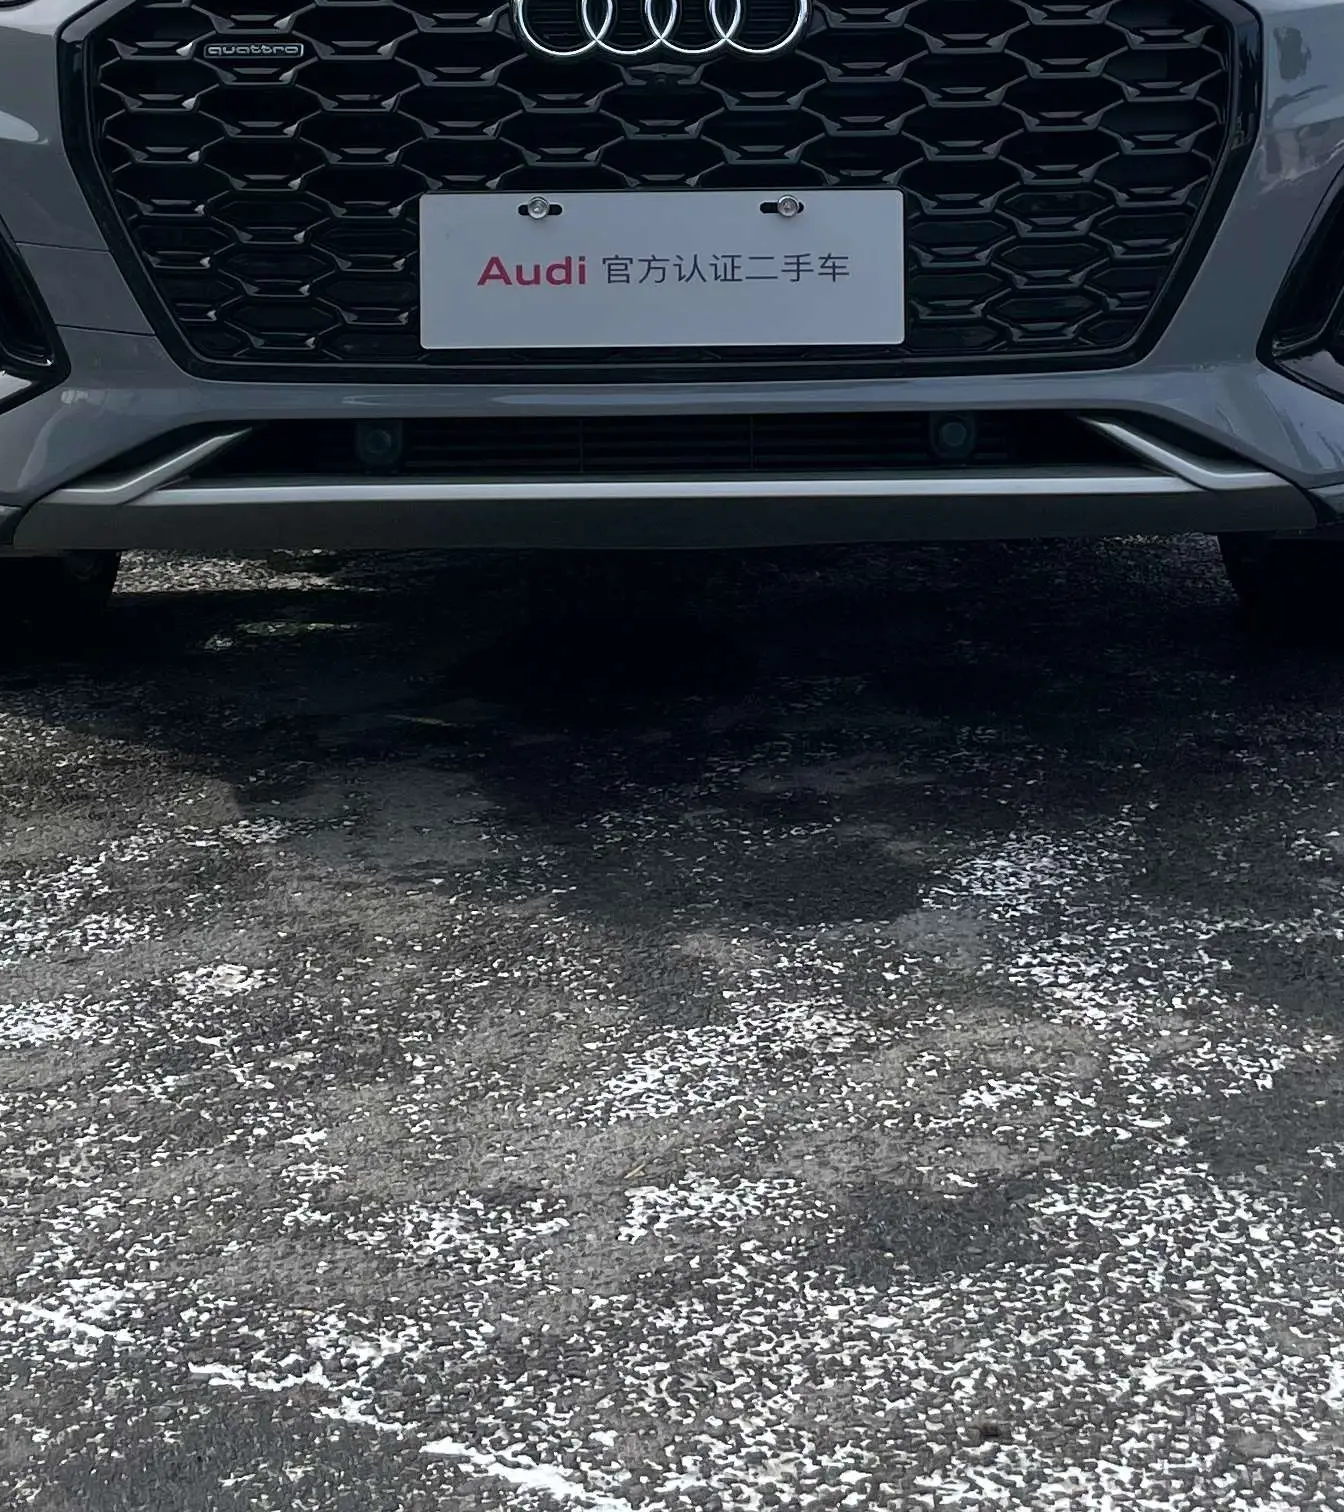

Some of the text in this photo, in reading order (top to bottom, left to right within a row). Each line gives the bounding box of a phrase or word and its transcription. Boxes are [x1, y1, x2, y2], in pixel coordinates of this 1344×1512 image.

[208, 45, 298, 56] quattro
[477, 254, 851, 286] Audi 官方认证二手车
